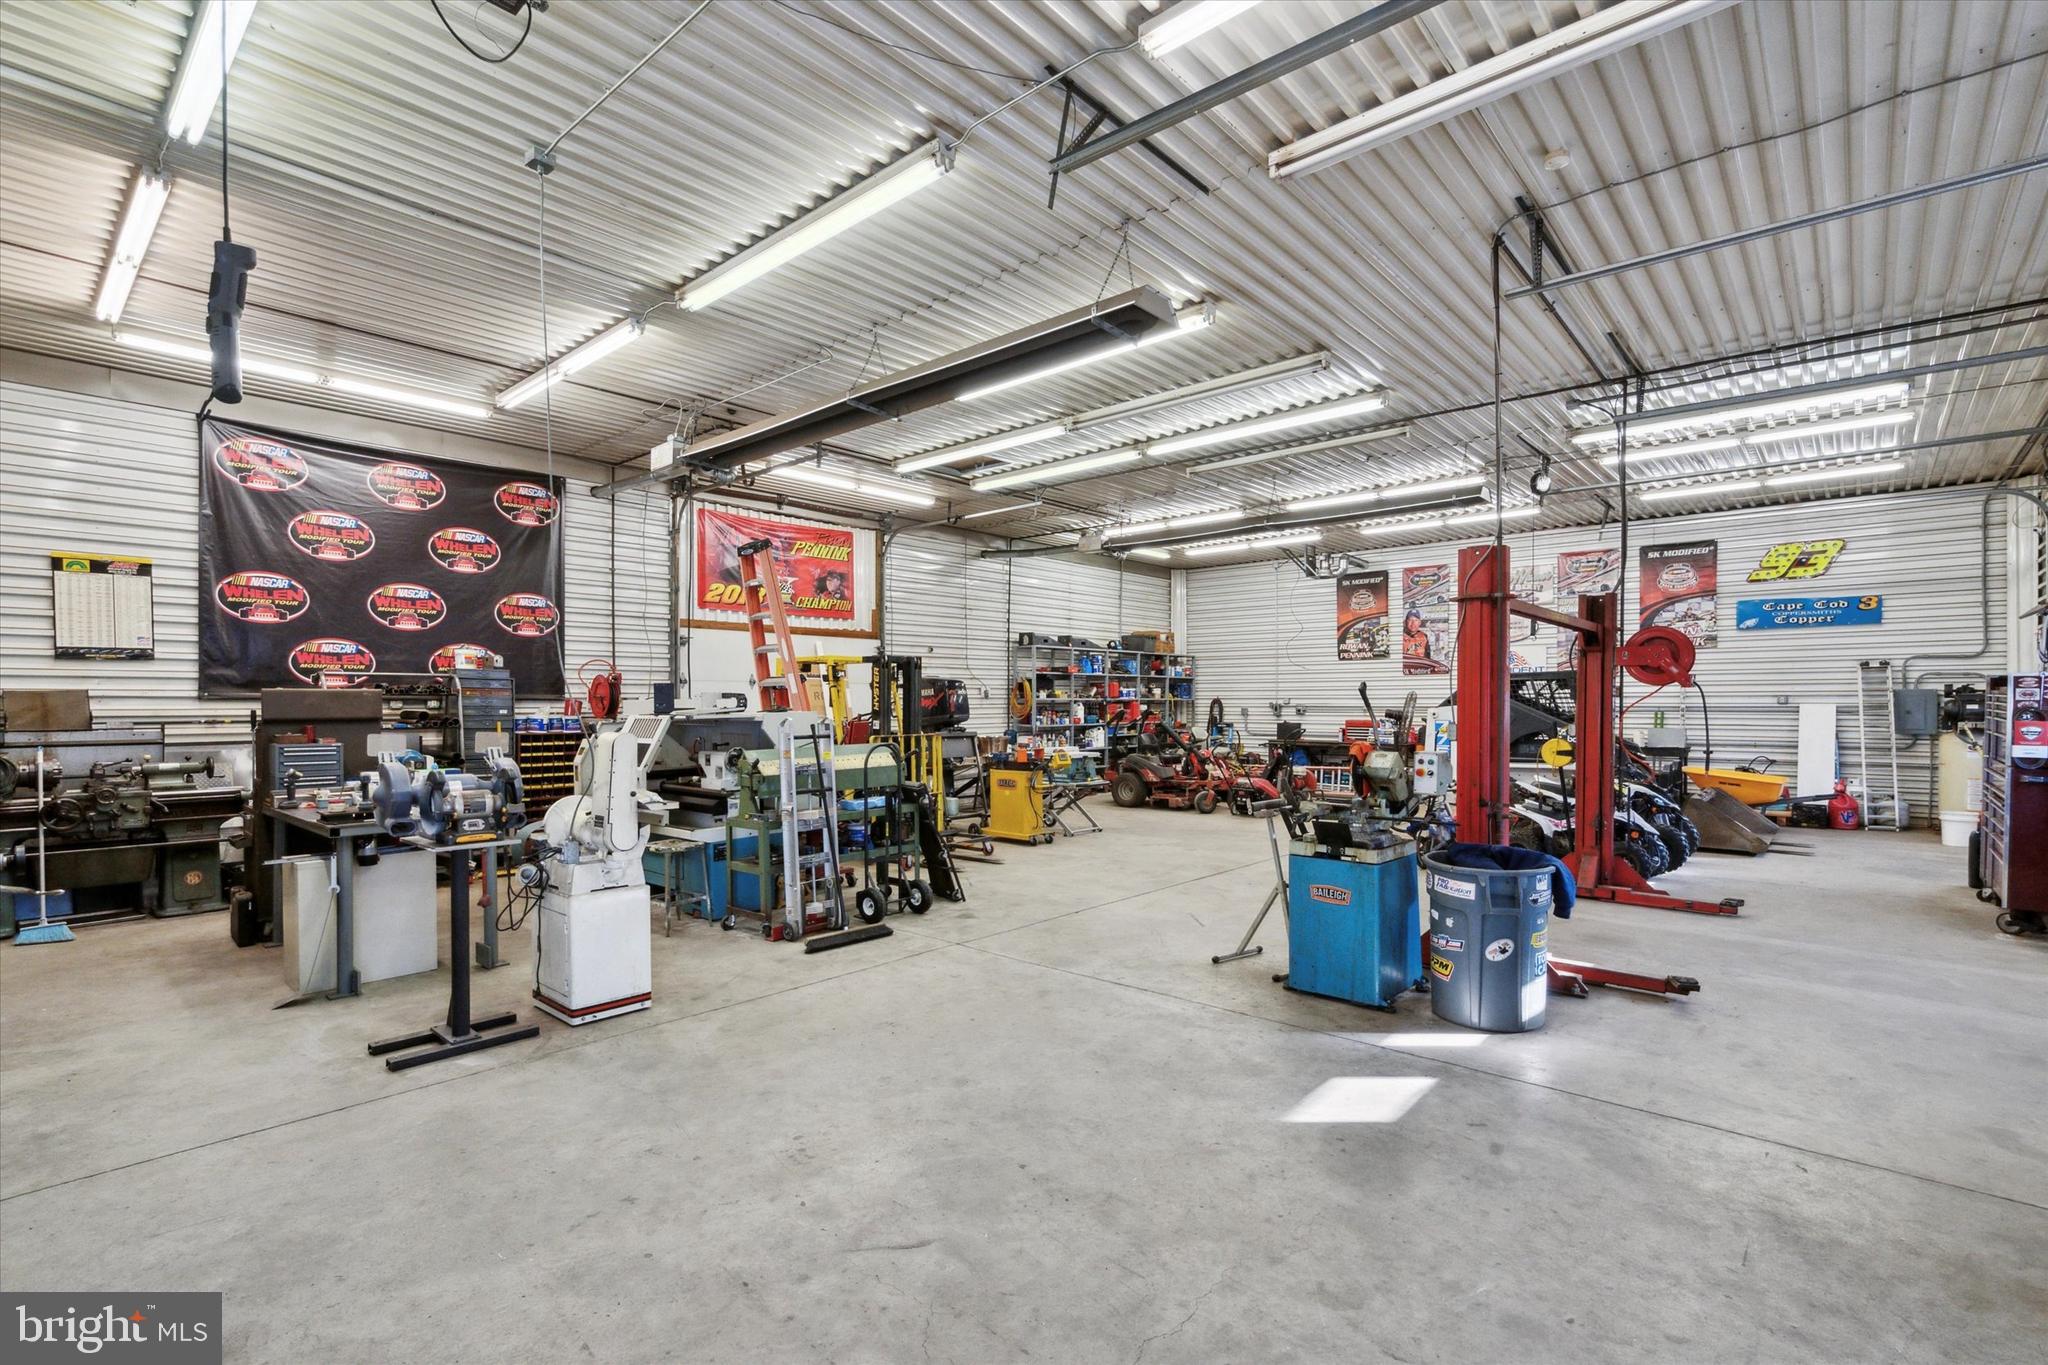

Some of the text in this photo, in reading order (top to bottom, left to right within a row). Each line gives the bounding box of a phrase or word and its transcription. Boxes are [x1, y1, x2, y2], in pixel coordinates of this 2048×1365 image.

[250, 444, 288, 457] NASCAR
[273, 467, 298, 476] TOUR
[396, 467, 428, 479] NASCAR
[373, 474, 441, 492] WHELEN
[518, 487, 546, 498] NASCAR
[320, 516, 356, 528] NASCAR
[294, 521, 370, 541] WHELEN
[299, 534, 341, 543] MODIFIED
[455, 532, 485, 543] NASCAR
[433, 537, 497, 556] WHELEN
[790, 541, 852, 561] PENNINK
[437, 549, 473, 557] MODIFIED
[1648, 551, 1661, 559] SK
[250, 576, 289, 588] NASCAR
[222, 583, 304, 602] WHELEN
[396, 588, 429, 599] NASCAR
[226, 596, 272, 605] MODIFIED
[373, 594, 442, 611] WHELEN
[518, 597, 546, 607] NASCAR
[796, 596, 852, 611] CHAMPION
[1814, 599, 1848, 609] Cod
[377, 606, 415, 614] MODIFIED
[500, 603, 554, 617] WHELEN
[1774, 615, 1834, 625] Copper
[320, 643, 356, 654] NASCAR
[294, 651, 370, 666] WHELEN
[1313, 887, 1347, 900] BAILEIGH
